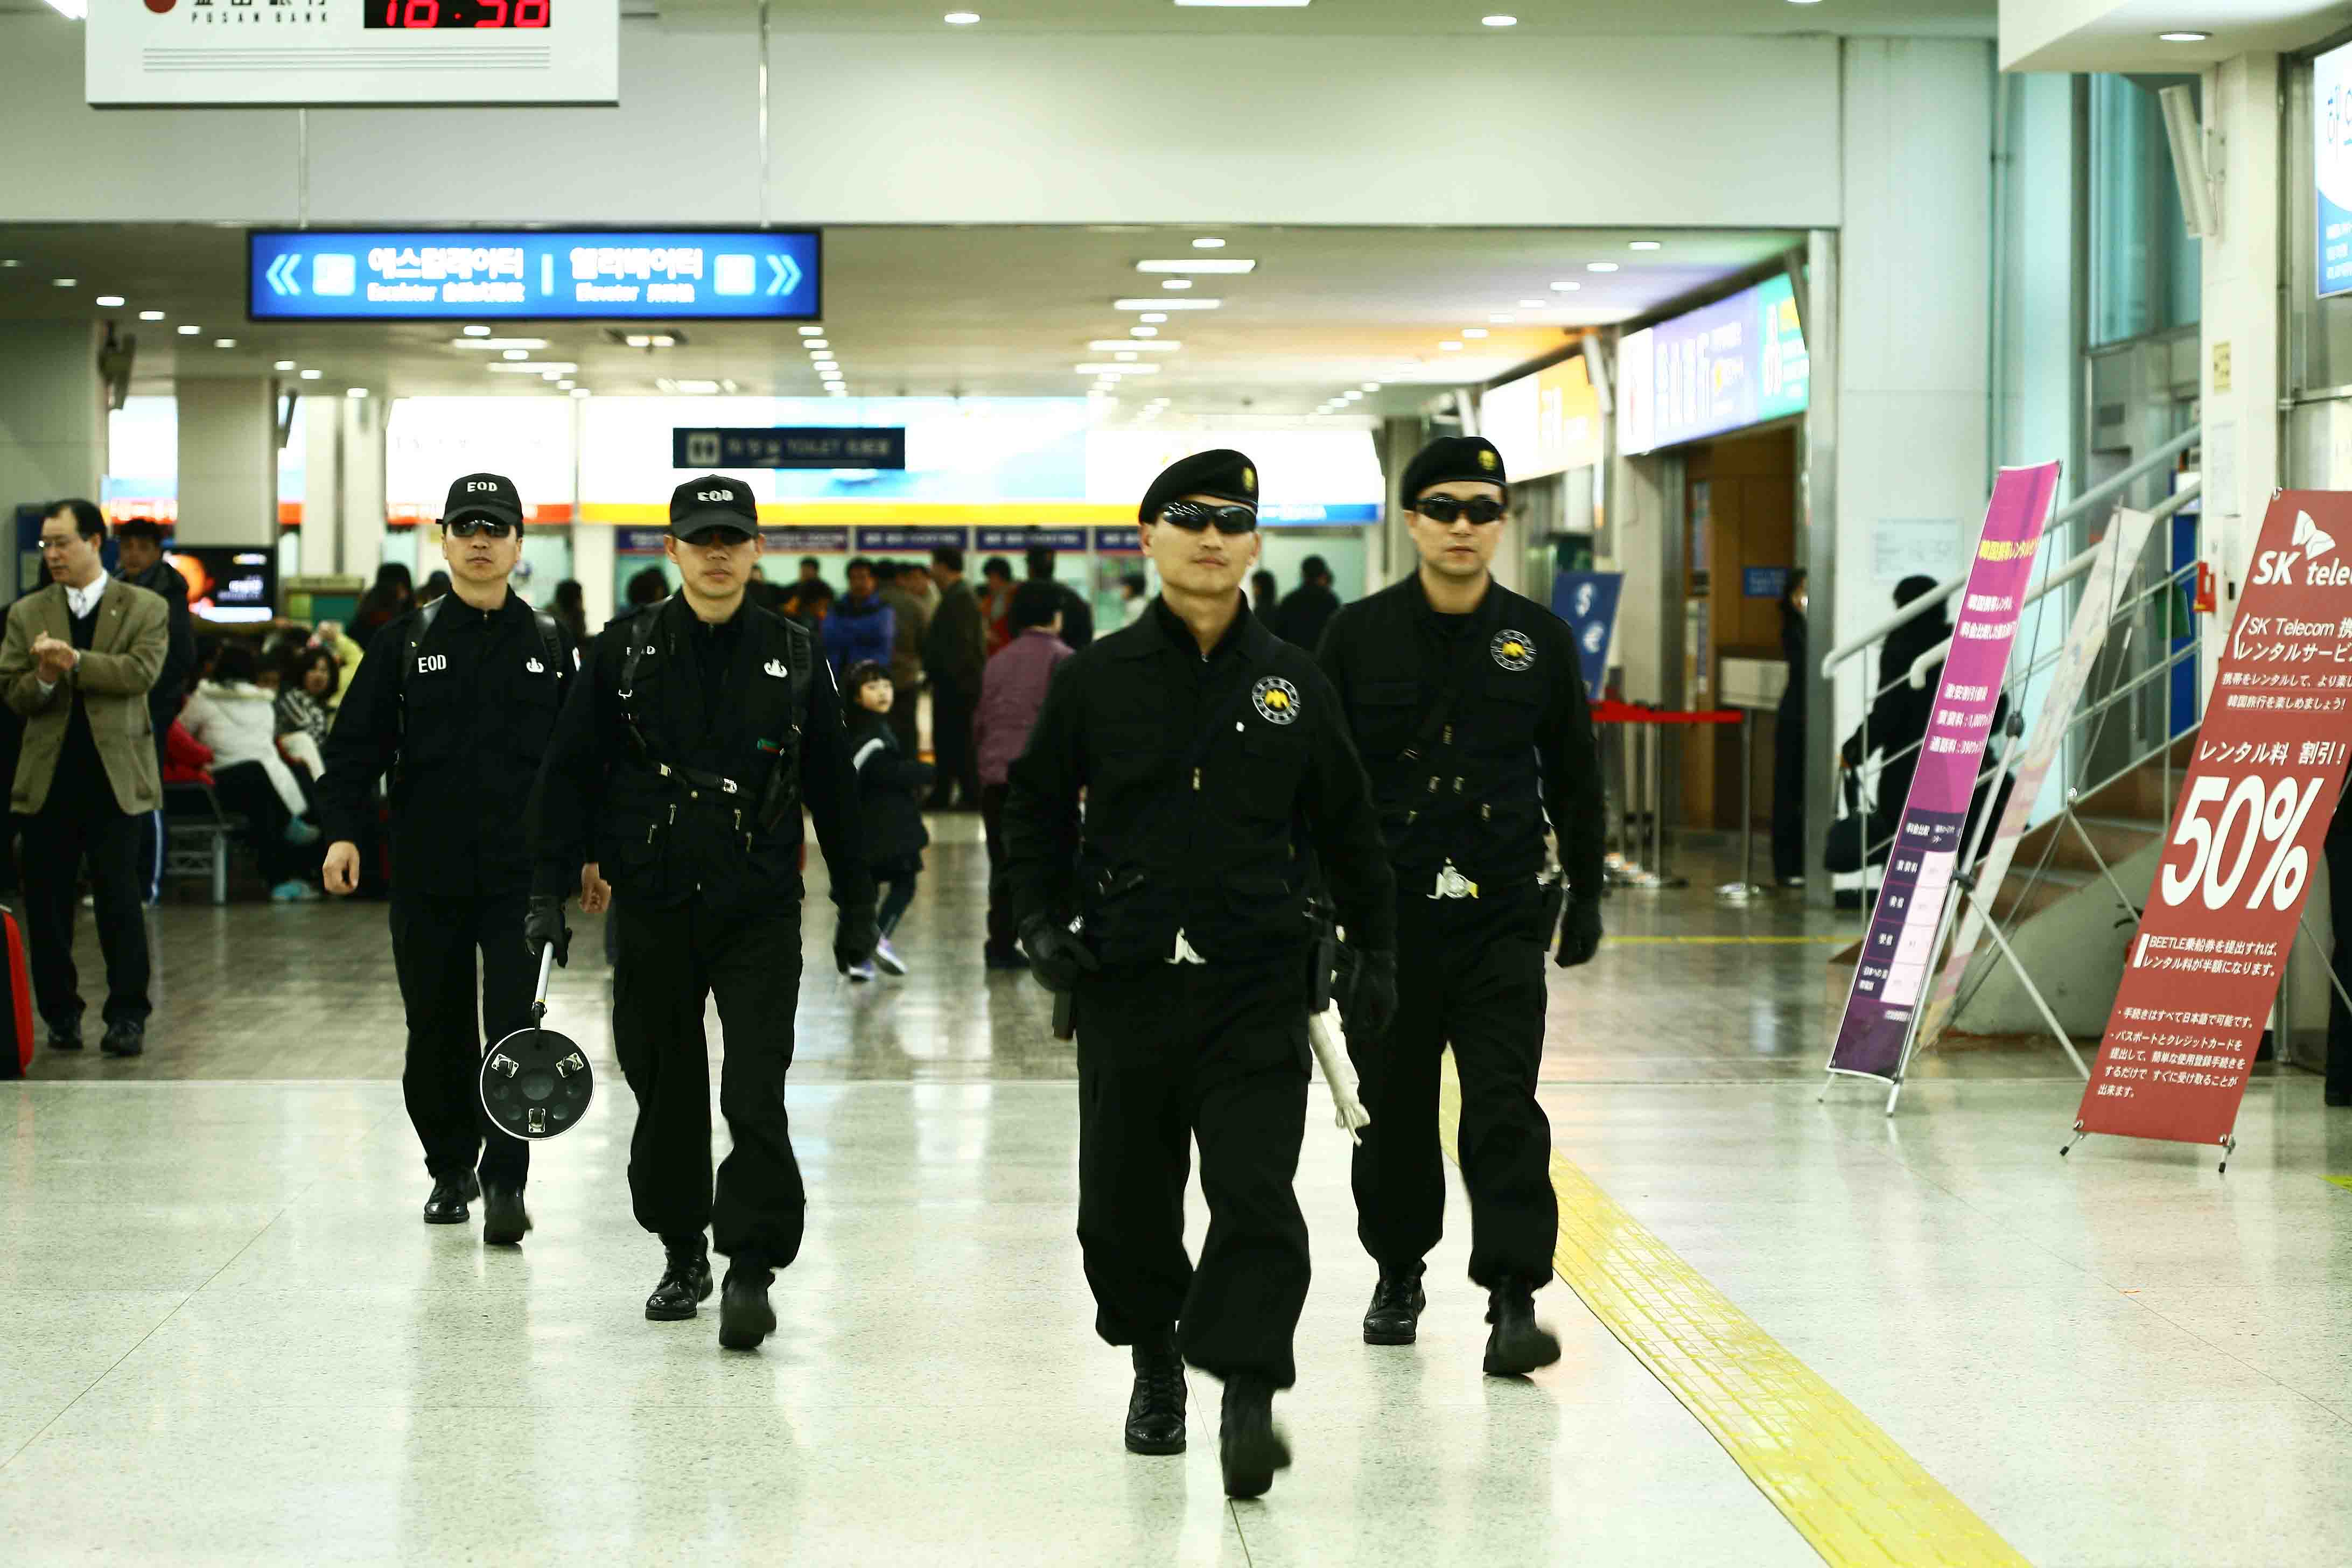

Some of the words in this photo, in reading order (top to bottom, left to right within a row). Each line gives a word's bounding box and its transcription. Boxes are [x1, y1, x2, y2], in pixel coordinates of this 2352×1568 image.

[467, 482, 498, 492] EOD
[697, 489, 733, 501] EOD
[2252, 551, 2301, 586] SK
[2306, 557, 2352, 586] tele
[2248, 617, 2271, 635] SK
[2276, 618, 2335, 636] Telecom
[2238, 641, 2352, 663] レンタルサービ
[418, 654, 446, 673] EOD
[2199, 740, 2289, 766] レンタル料
[2162, 775, 2325, 911] 50%
